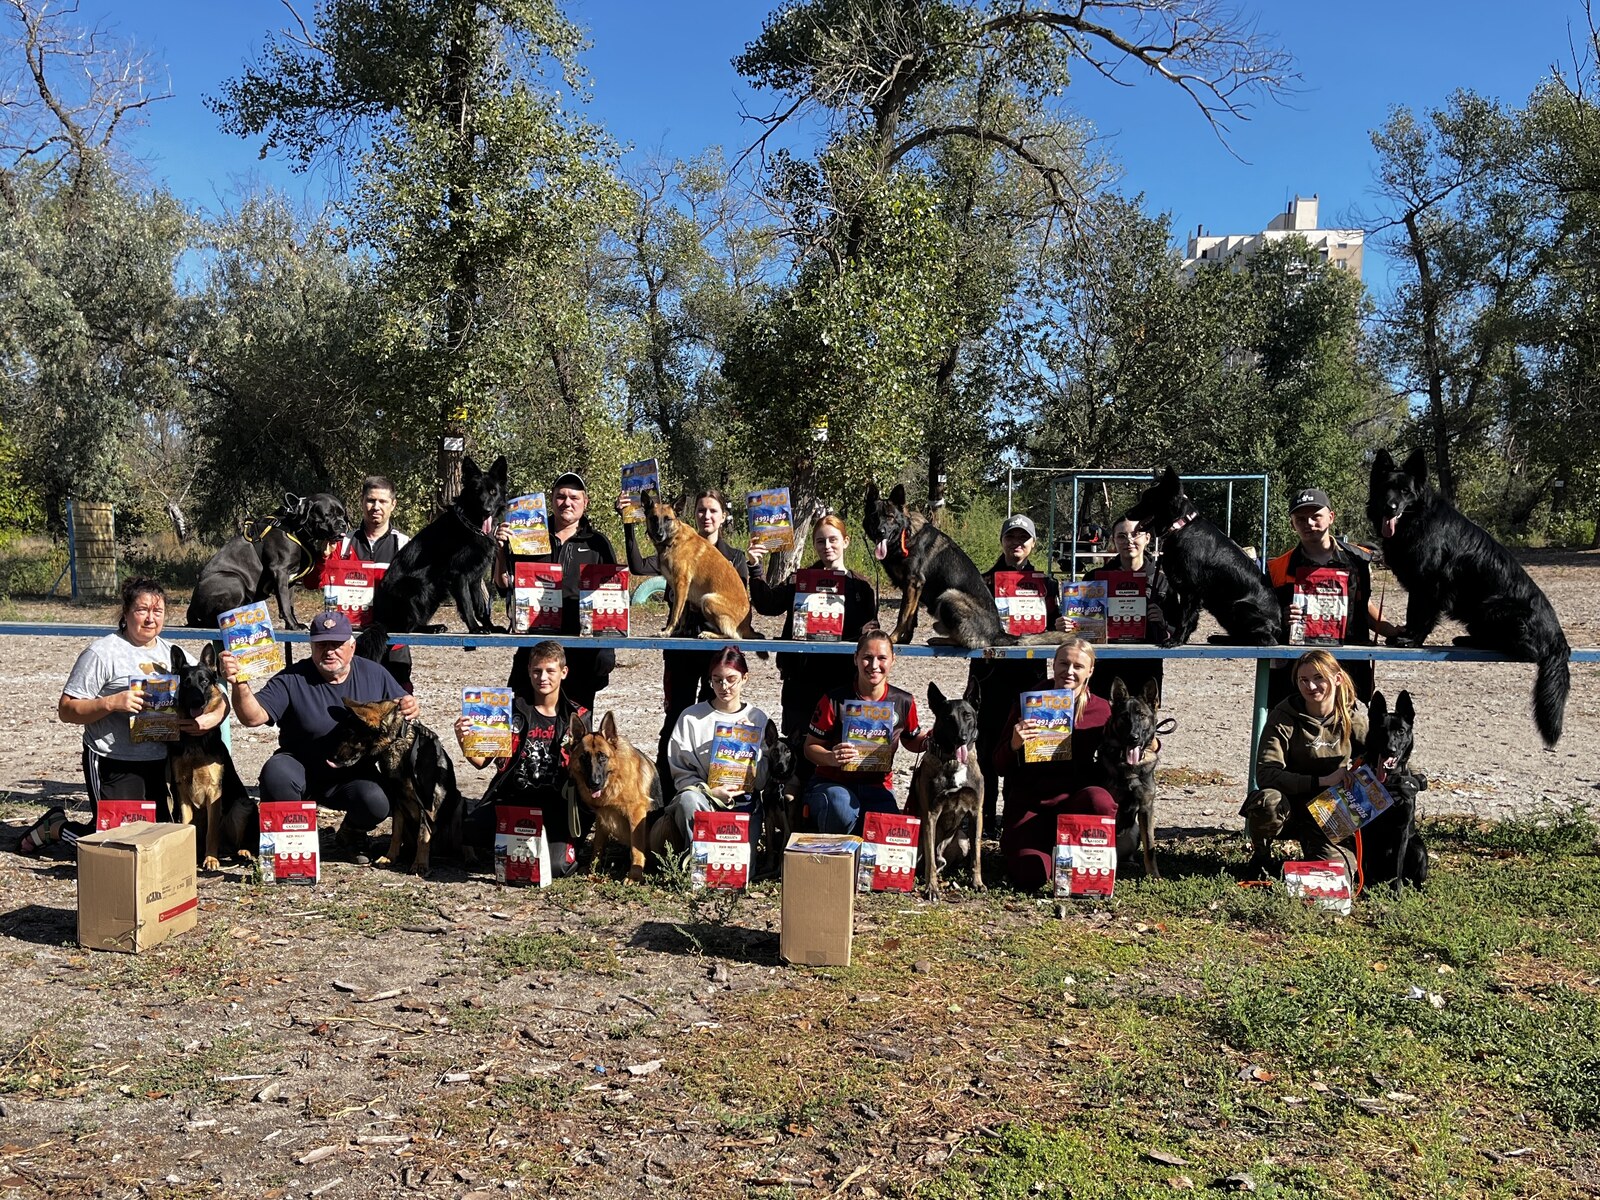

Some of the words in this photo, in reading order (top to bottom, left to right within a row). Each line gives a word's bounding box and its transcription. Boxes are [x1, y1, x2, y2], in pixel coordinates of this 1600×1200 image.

[512, 517, 543, 525] 1991-2026
[755, 513, 787, 522] 1991-2026
[234, 608, 266, 625] ТСО
[231, 630, 268, 646] 1991-2026
[1044, 695, 1072, 710] ТСО
[863, 706, 891, 721] ТСО
[1036, 718, 1068, 726] 991-2026
[720, 749, 754, 758] 1991-2026
[281, 813, 309, 824] ACANA
[716, 824, 741, 835] ACANA
[887, 827, 911, 838] ACANA
[1081, 828, 1107, 839] ACANA
[145, 891, 163, 905] ACANA
